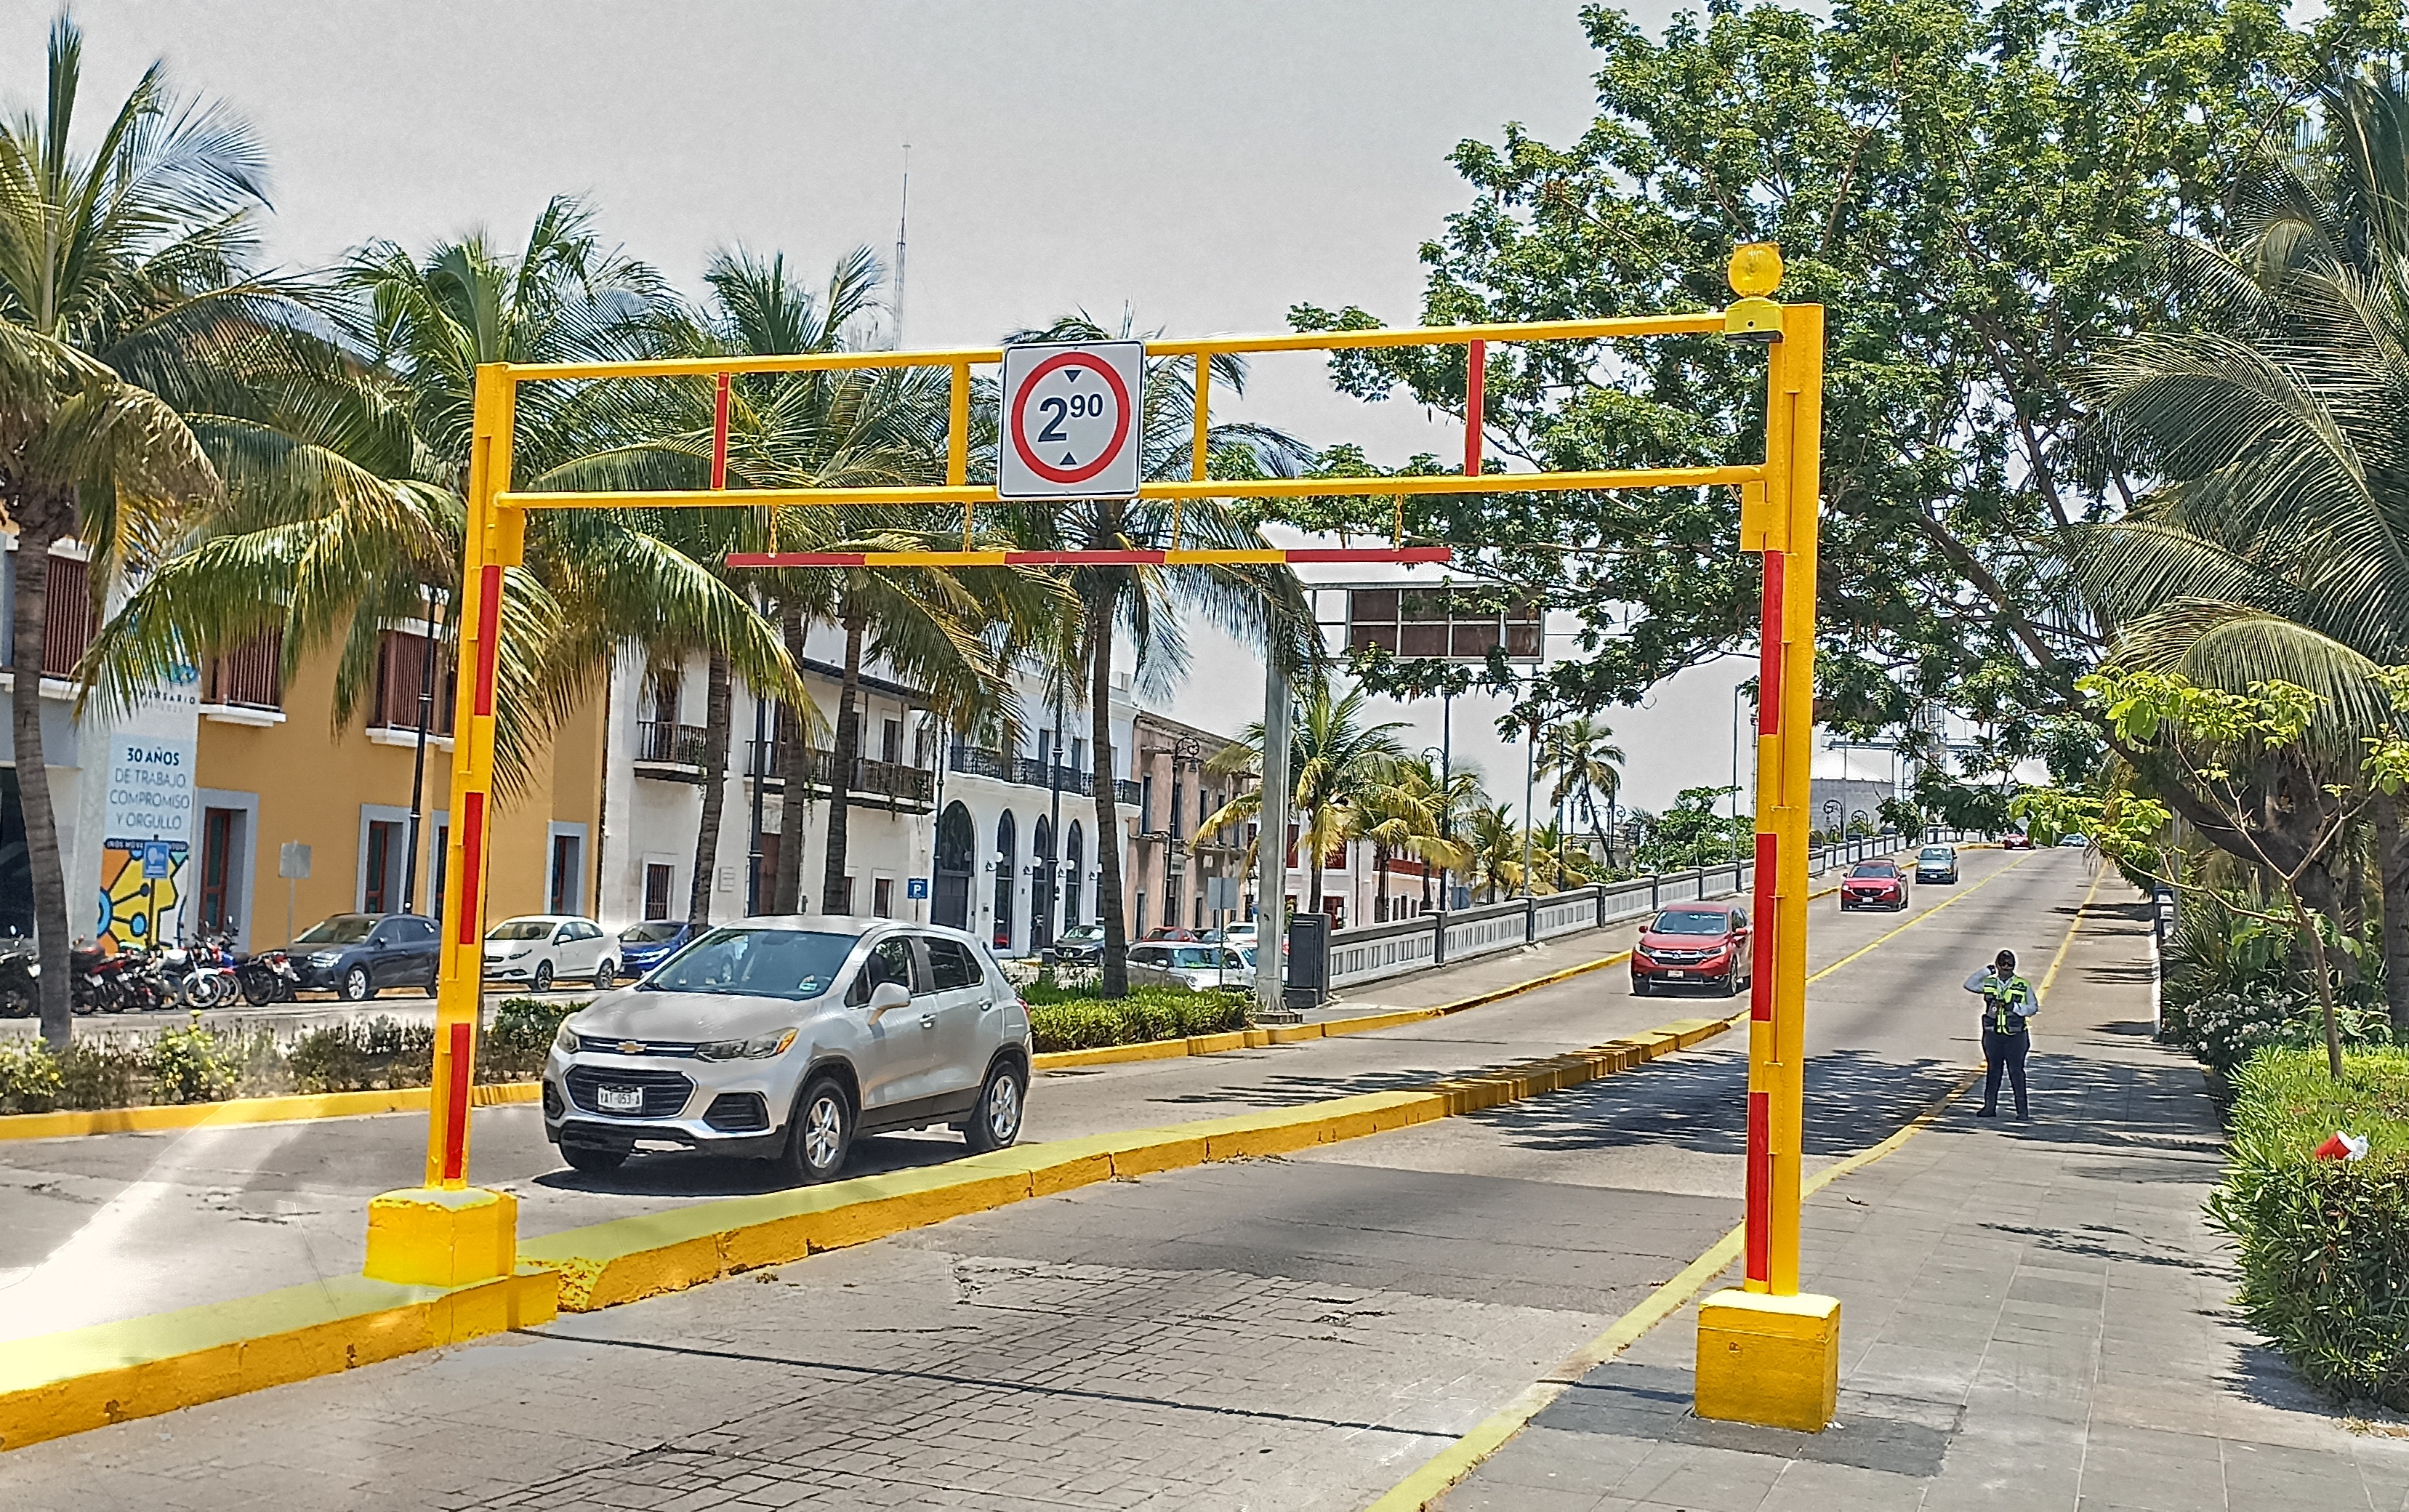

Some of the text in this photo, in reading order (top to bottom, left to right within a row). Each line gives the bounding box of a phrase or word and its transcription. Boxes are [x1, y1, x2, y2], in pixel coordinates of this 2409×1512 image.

[127, 747, 180, 765] 30 AÑOS
[115, 768, 130, 784] DE
[110, 789, 190, 808] COMPROMISO
[116, 812, 182, 830] Y ORGULLO
[914, 884, 922, 894] P
